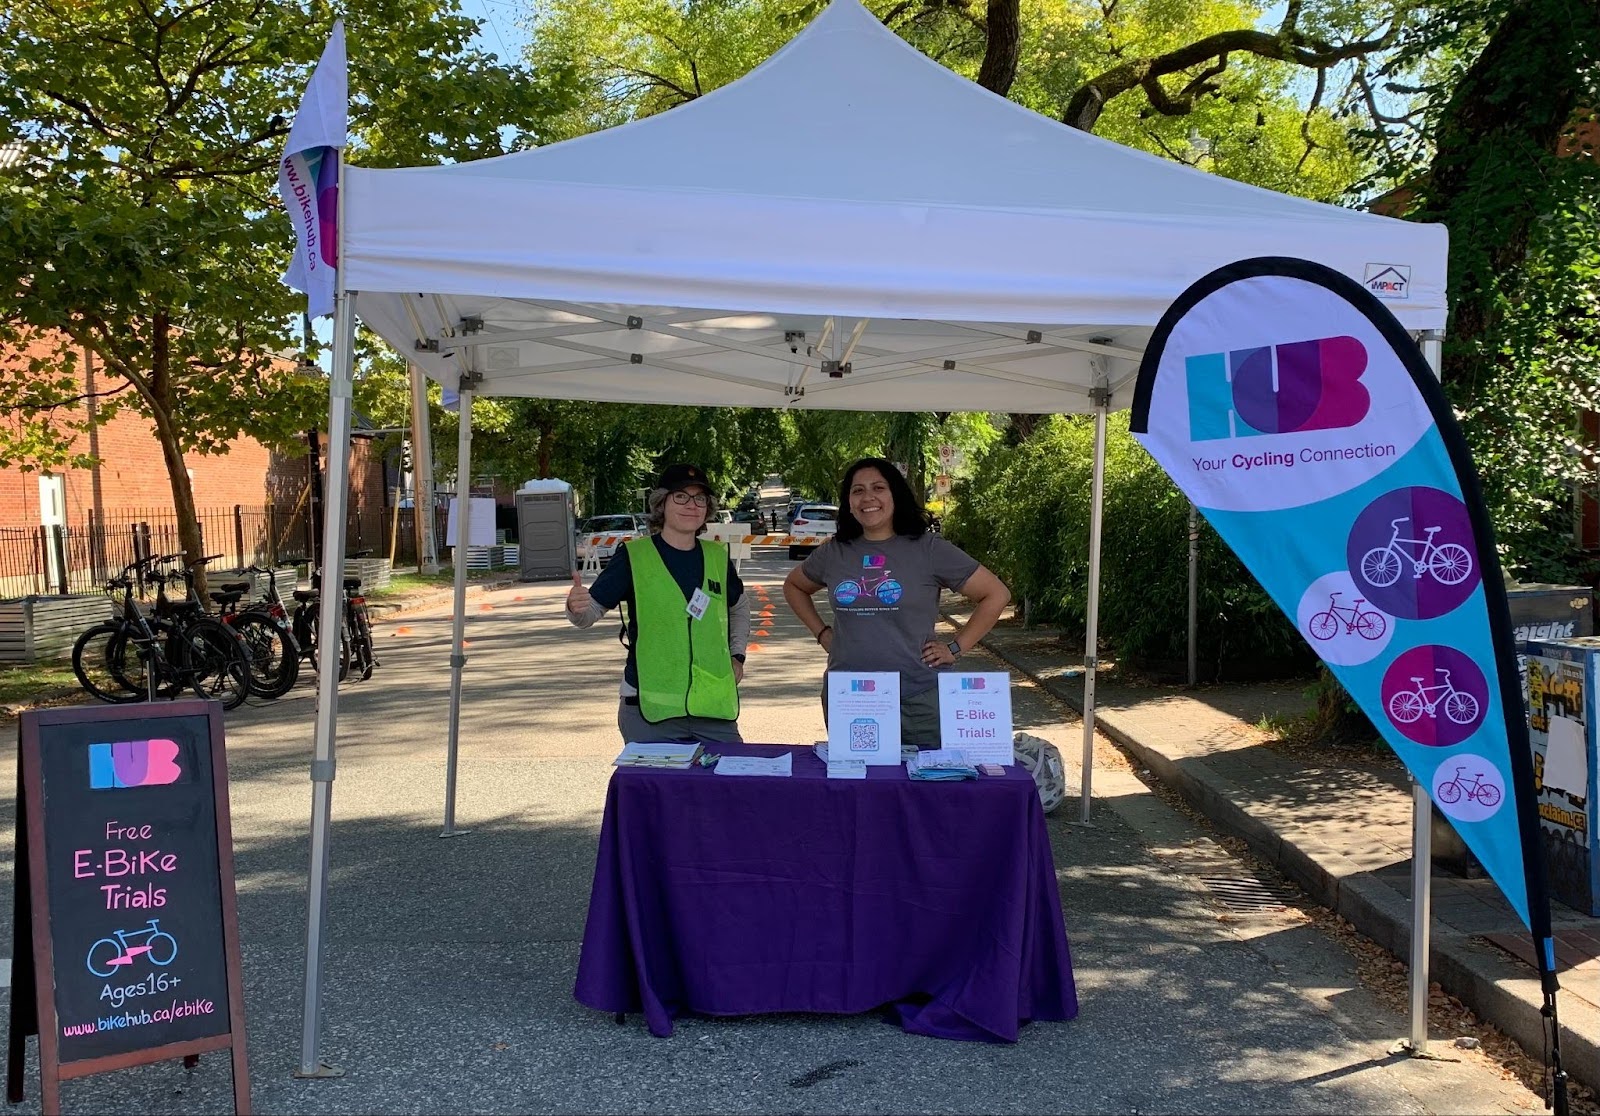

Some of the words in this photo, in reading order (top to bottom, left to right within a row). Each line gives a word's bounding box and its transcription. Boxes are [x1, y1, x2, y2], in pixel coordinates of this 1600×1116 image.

[284, 156, 316, 271] ww.bikehub.ca
[1185, 336, 1371, 441] HUB
[1192, 457, 1227, 472] Your
[1232, 452, 1294, 470] Cycling
[1299, 443, 1396, 463] Connection
[956, 709, 996, 720] E-Bike
[957, 727, 996, 738] Trials!
[88, 739, 181, 789] HUB
[106, 821, 152, 840] Free
[100, 882, 167, 910] Trials
